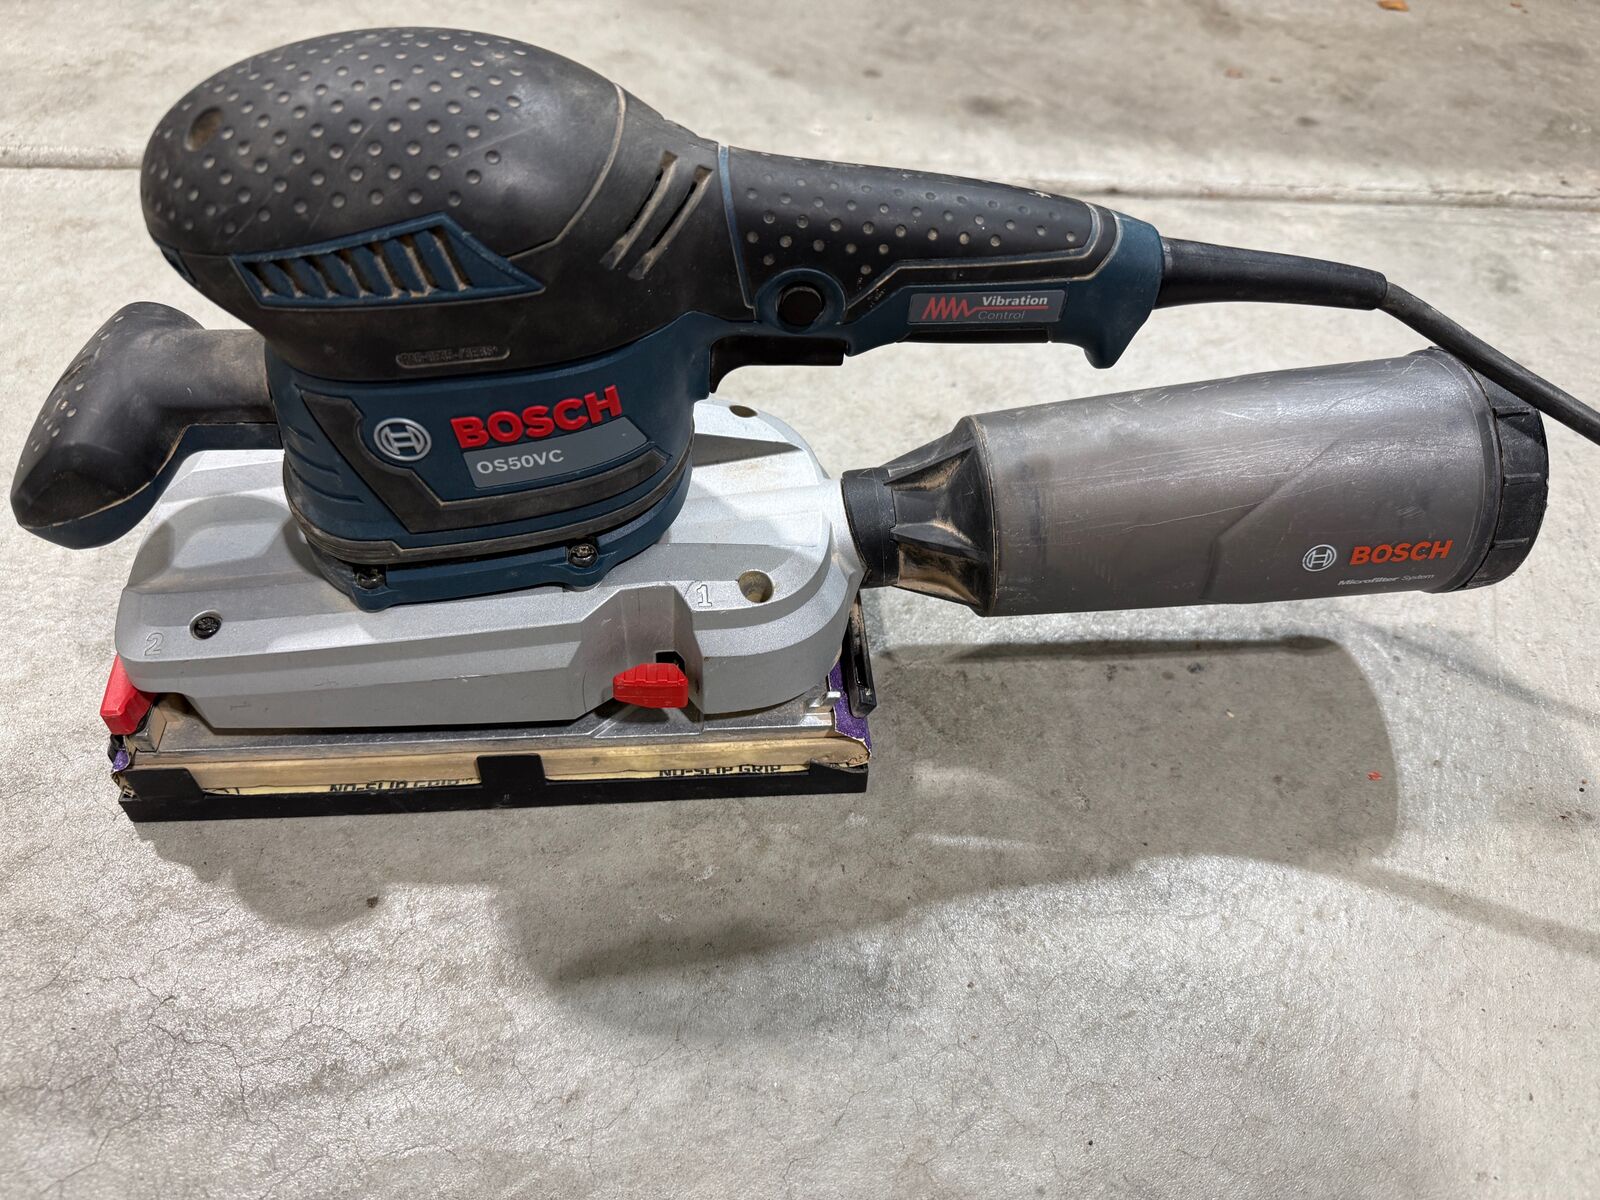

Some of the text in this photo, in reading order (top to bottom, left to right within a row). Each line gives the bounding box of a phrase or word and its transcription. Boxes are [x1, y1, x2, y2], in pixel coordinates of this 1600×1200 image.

[982, 296, 1048, 306] Vibration
[978, 310, 1025, 320] Control
[450, 384, 623, 449] BOSCH
[476, 449, 564, 474] OS50VC
[1350, 540, 1453, 565] BOSCH
[696, 584, 713, 607] 1
[144, 632, 164, 656] 2
